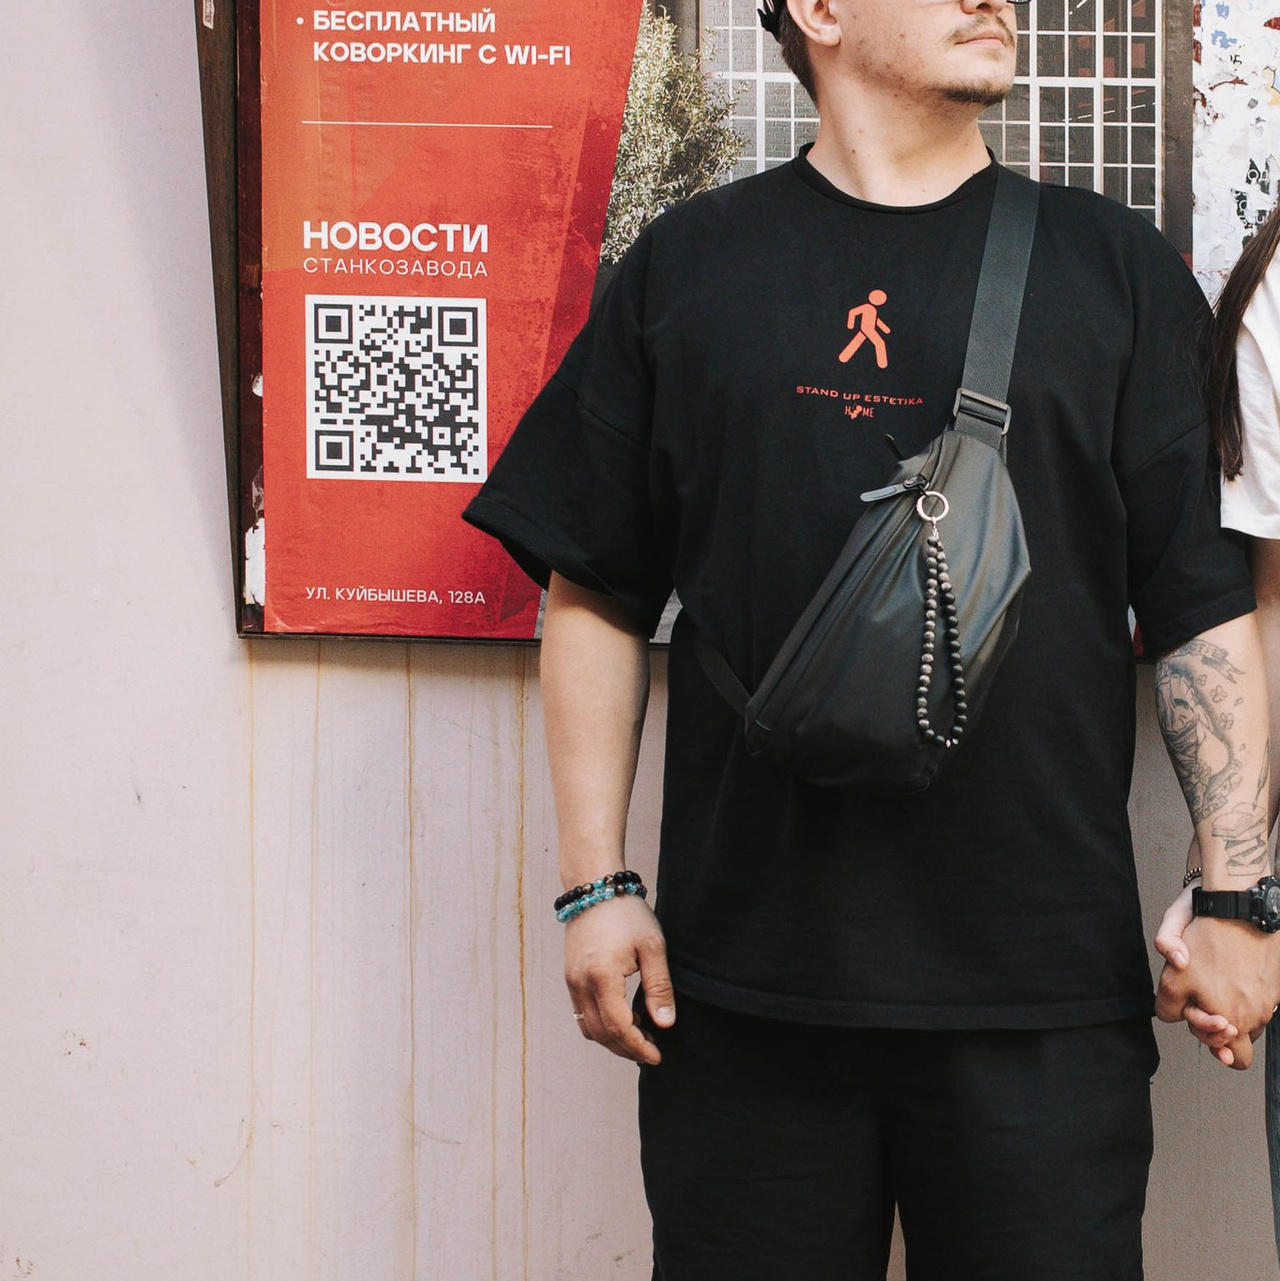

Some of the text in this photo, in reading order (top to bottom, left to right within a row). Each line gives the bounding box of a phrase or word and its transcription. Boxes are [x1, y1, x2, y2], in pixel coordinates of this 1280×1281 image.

[313, 8, 496, 33] БЕСПЛАТНЫЙ
[313, 42, 571, 66] КОВОРКИНГ С WI-FI
[303, 221, 488, 253] НОВОСТИ
[303, 257, 488, 279] СТАНКОЗАВОДА
[796, 385, 839, 398] STAND
[864, 394, 924, 405] ESTETIKA
[305, 584, 486, 605] УЛ. КУЙБЫШЕВА, 128А
